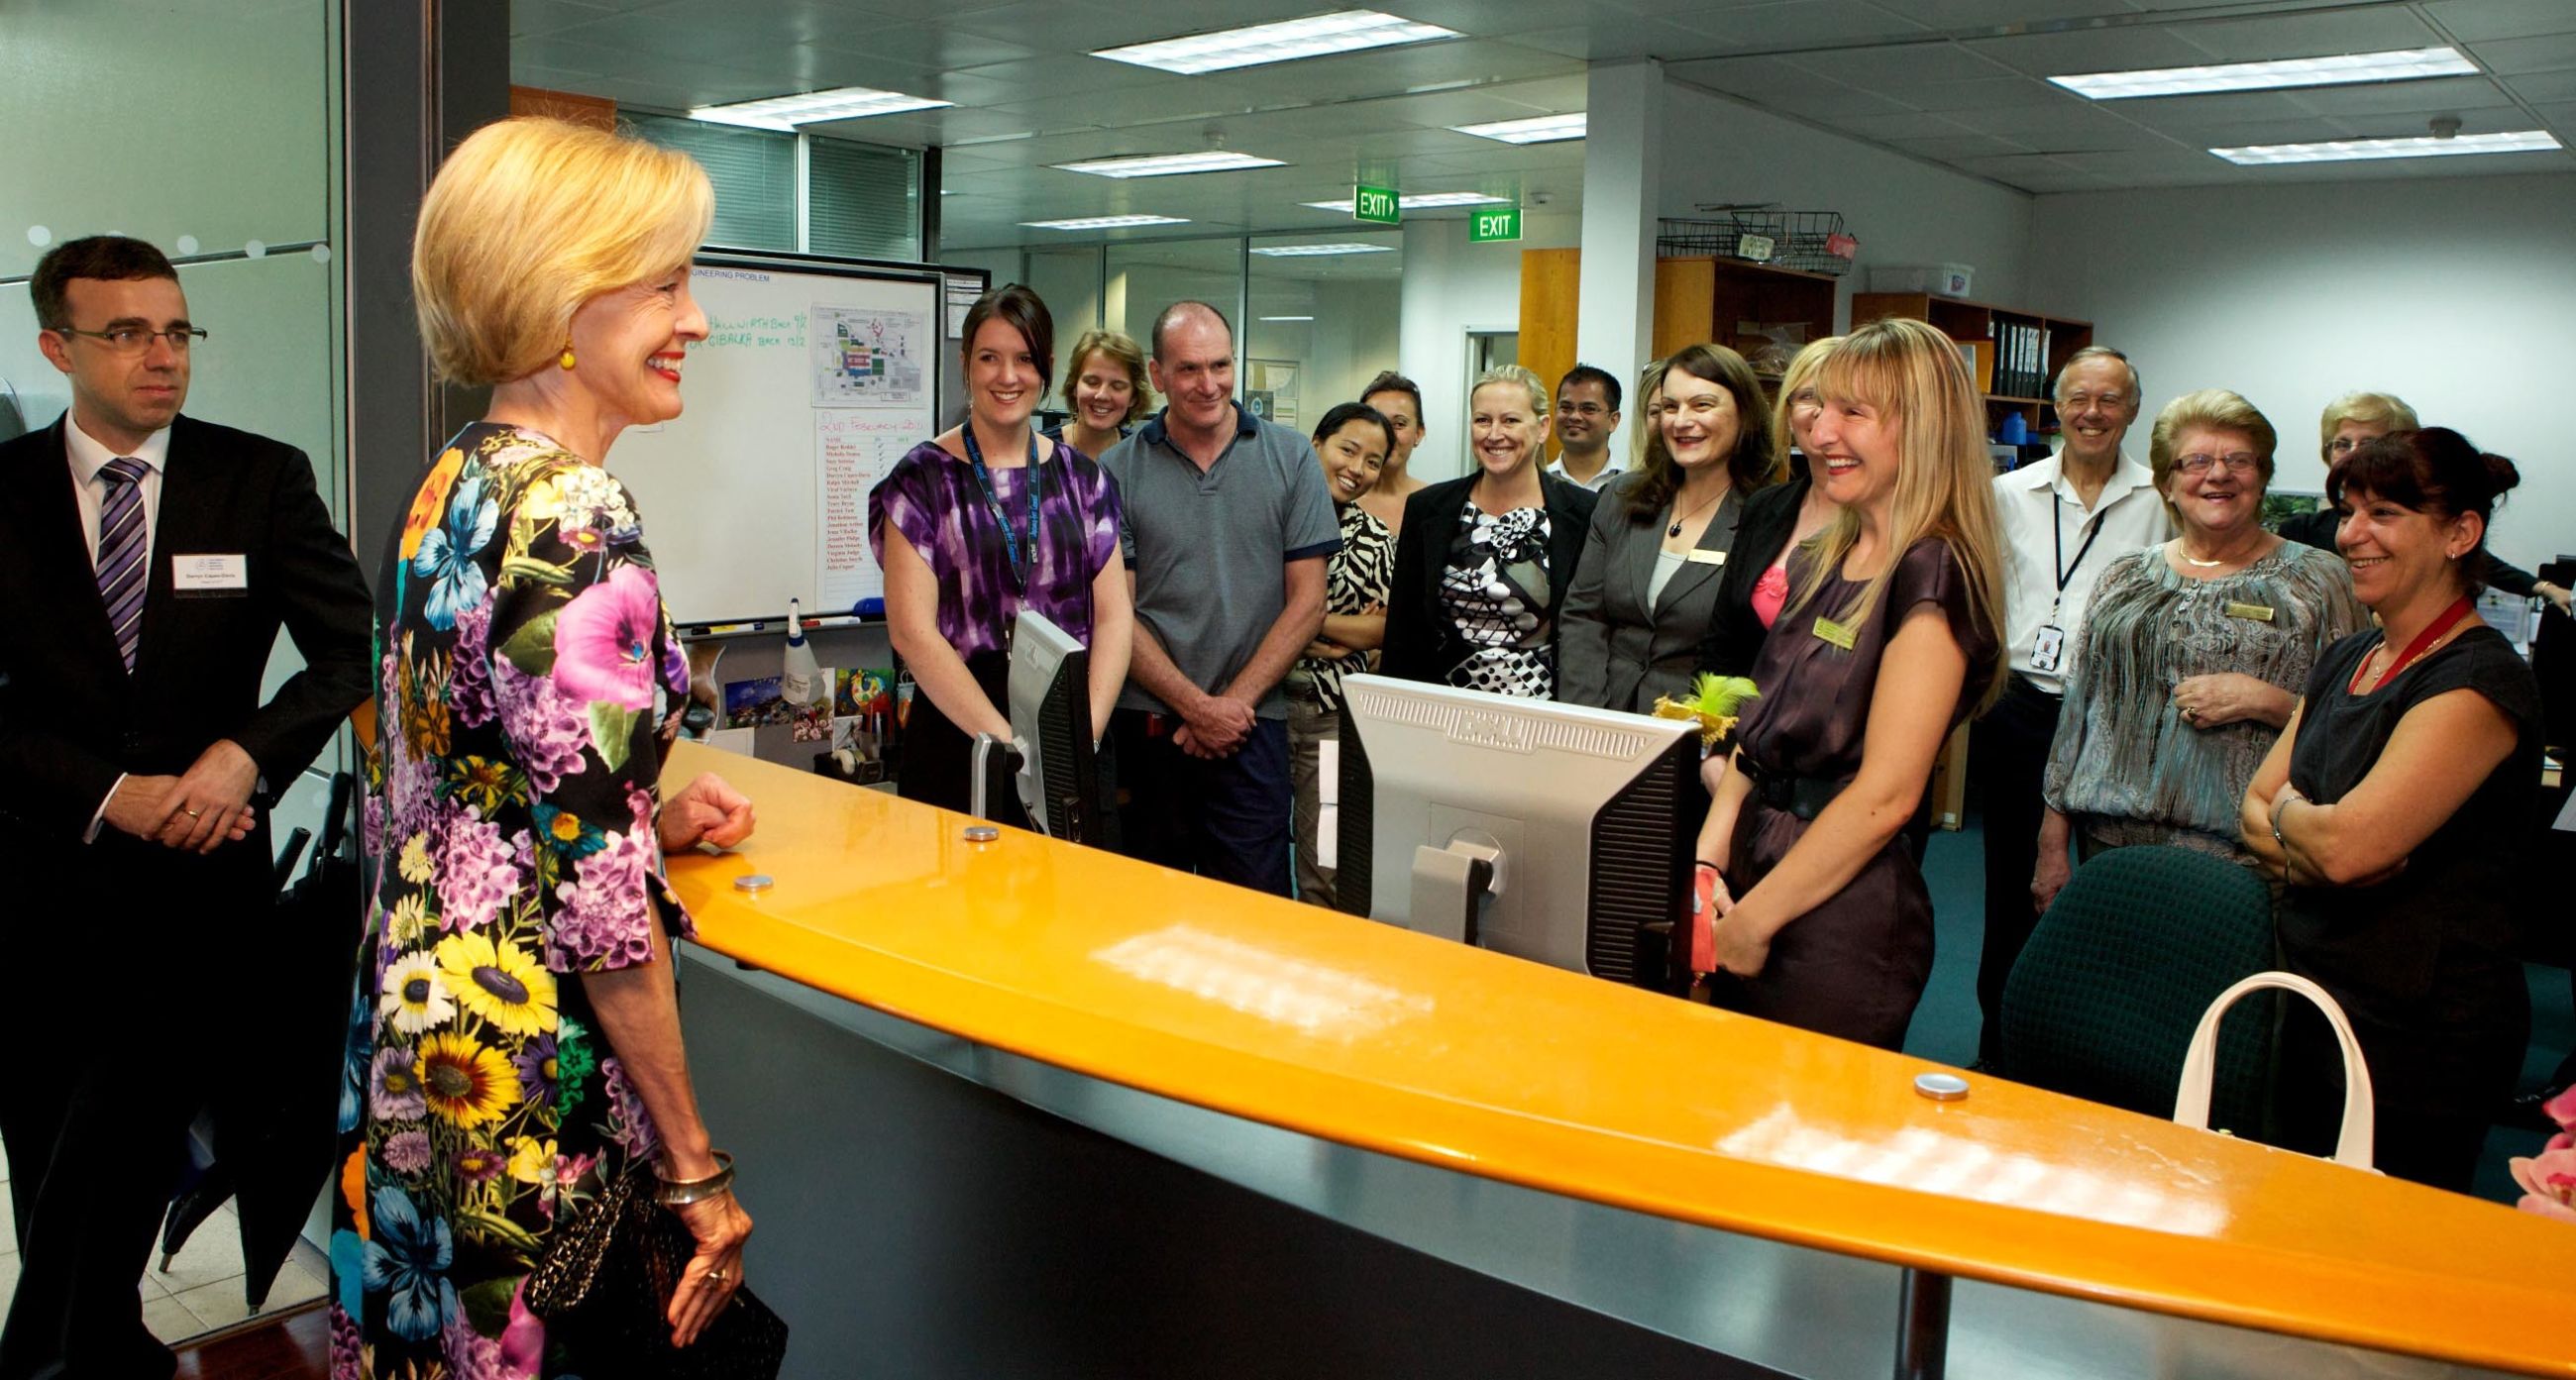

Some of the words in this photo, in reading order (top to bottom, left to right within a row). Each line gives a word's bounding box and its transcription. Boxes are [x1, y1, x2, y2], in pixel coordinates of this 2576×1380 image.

[1360, 192, 1386, 217] EXIT
[1479, 215, 1511, 237] EXIT
[692, 269, 734, 279] GINEERING
[735, 271, 770, 282] PROBLEM
